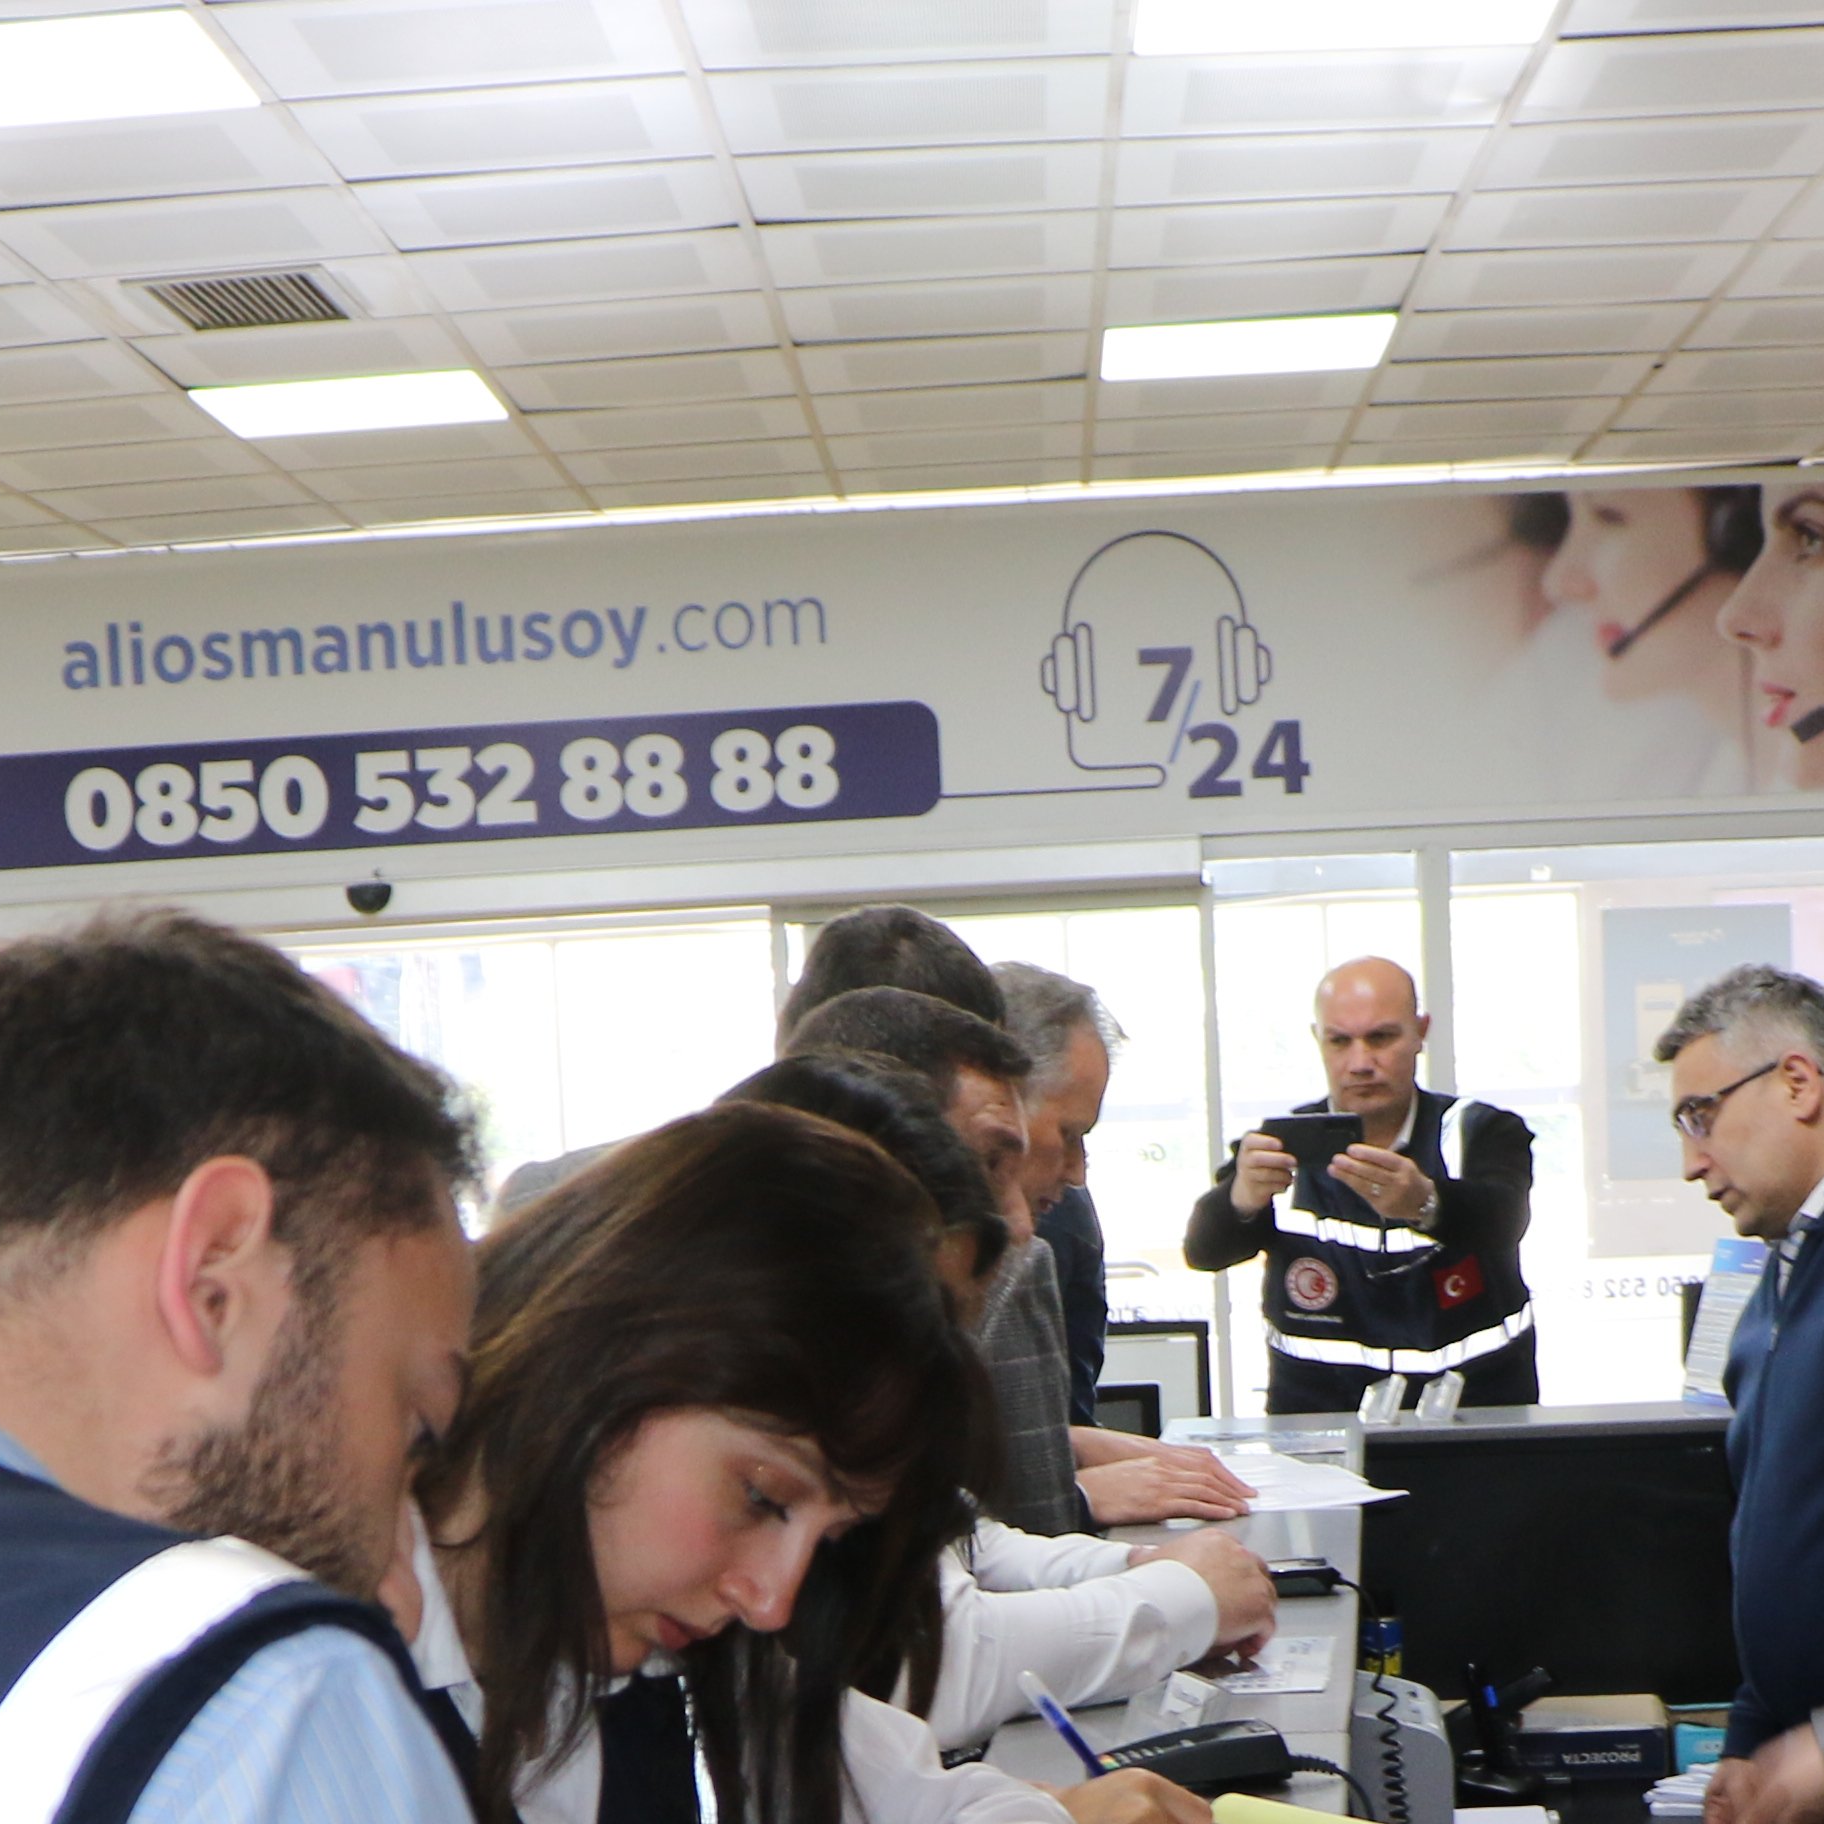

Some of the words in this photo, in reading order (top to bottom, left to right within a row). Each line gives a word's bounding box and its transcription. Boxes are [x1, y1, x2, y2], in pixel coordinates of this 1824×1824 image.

[61, 586, 829, 692] aliosmanulusoy.com
[64, 754, 330, 852] 0850
[353, 742, 539, 835] 532
[558, 733, 689, 823] 88
[709, 724, 840, 814] 88
